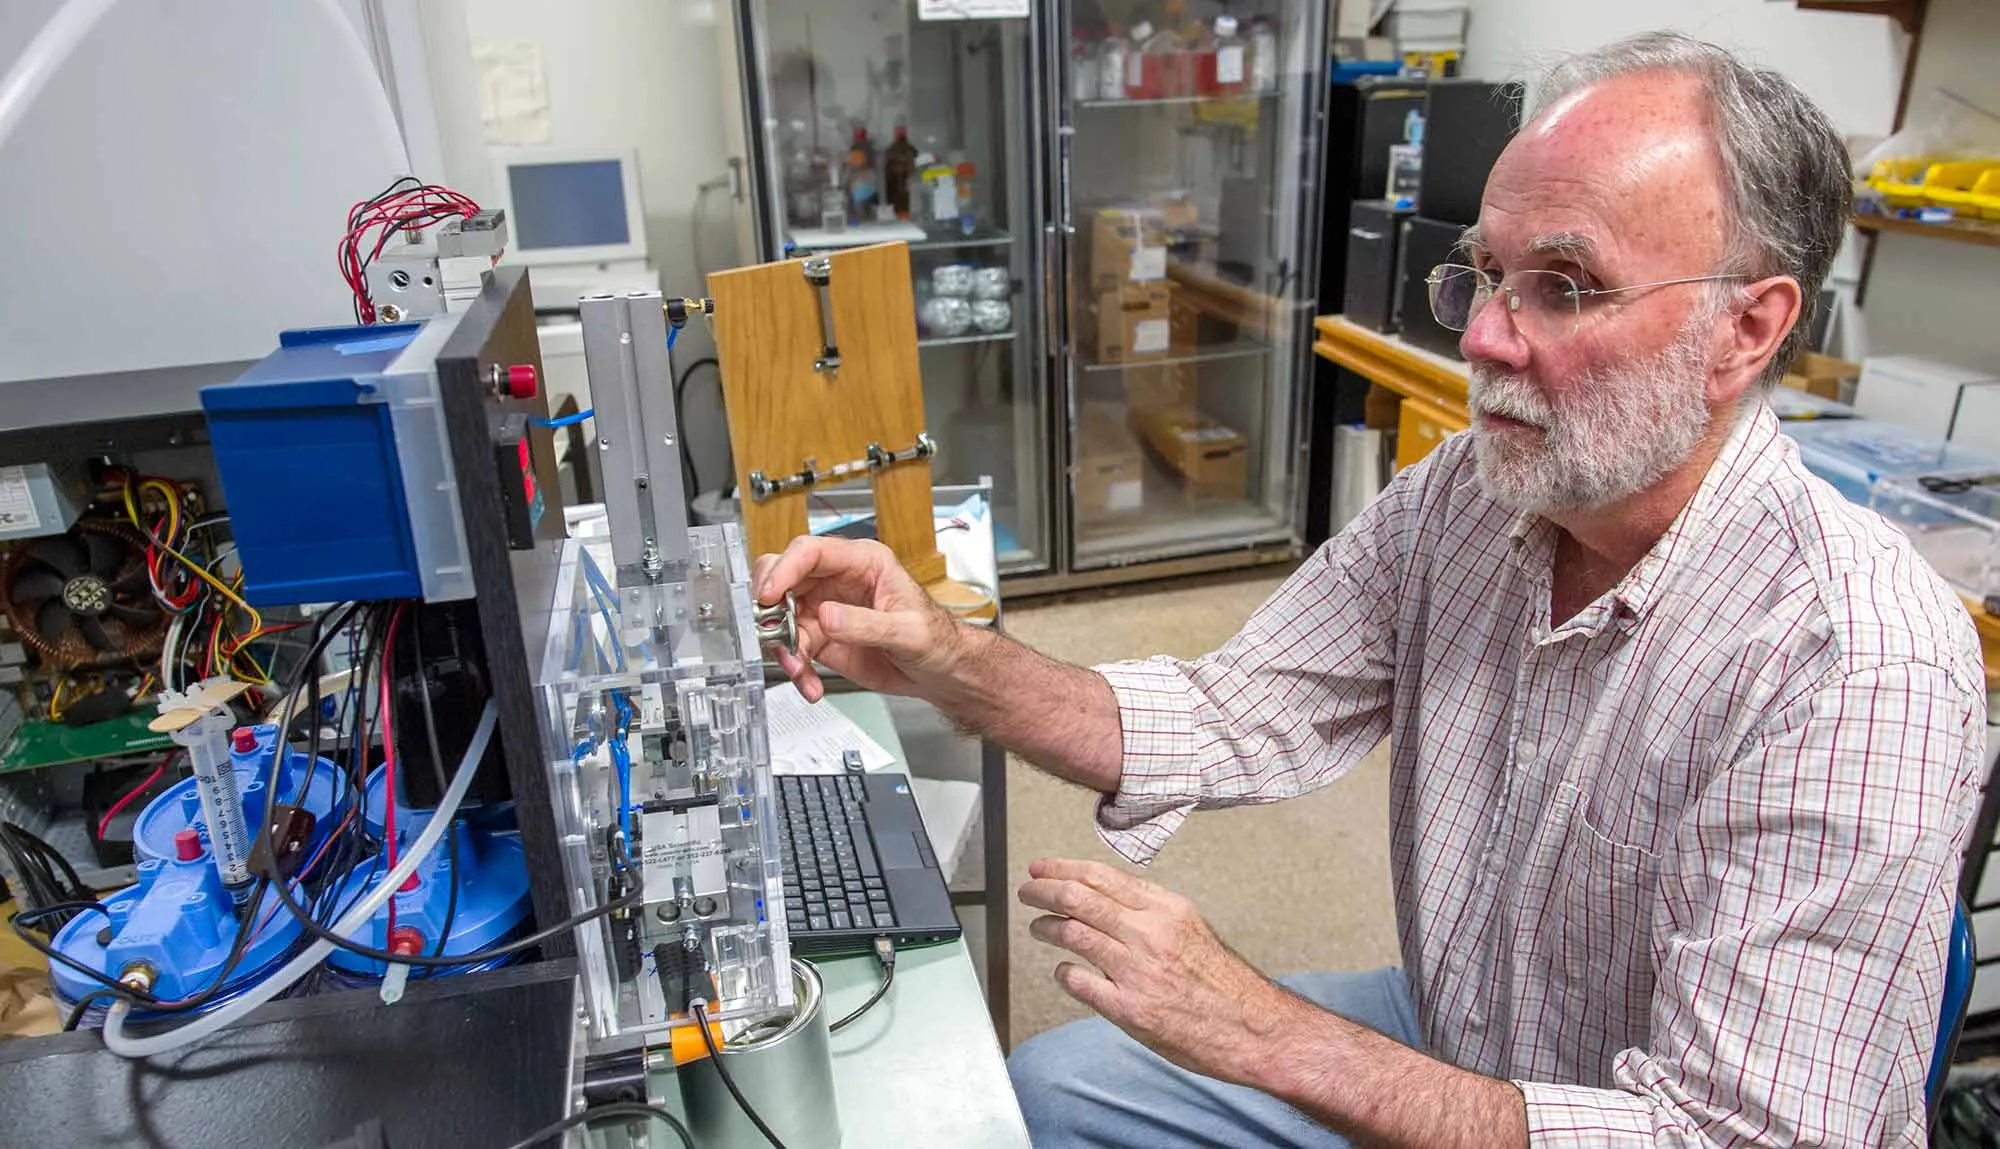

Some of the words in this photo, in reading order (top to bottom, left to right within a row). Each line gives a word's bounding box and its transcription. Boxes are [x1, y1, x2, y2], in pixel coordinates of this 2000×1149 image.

[220, 820, 227, 829] 6
[222, 831, 230, 840] 5
[227, 852, 235, 861] 3
[229, 863, 237, 872] 2
